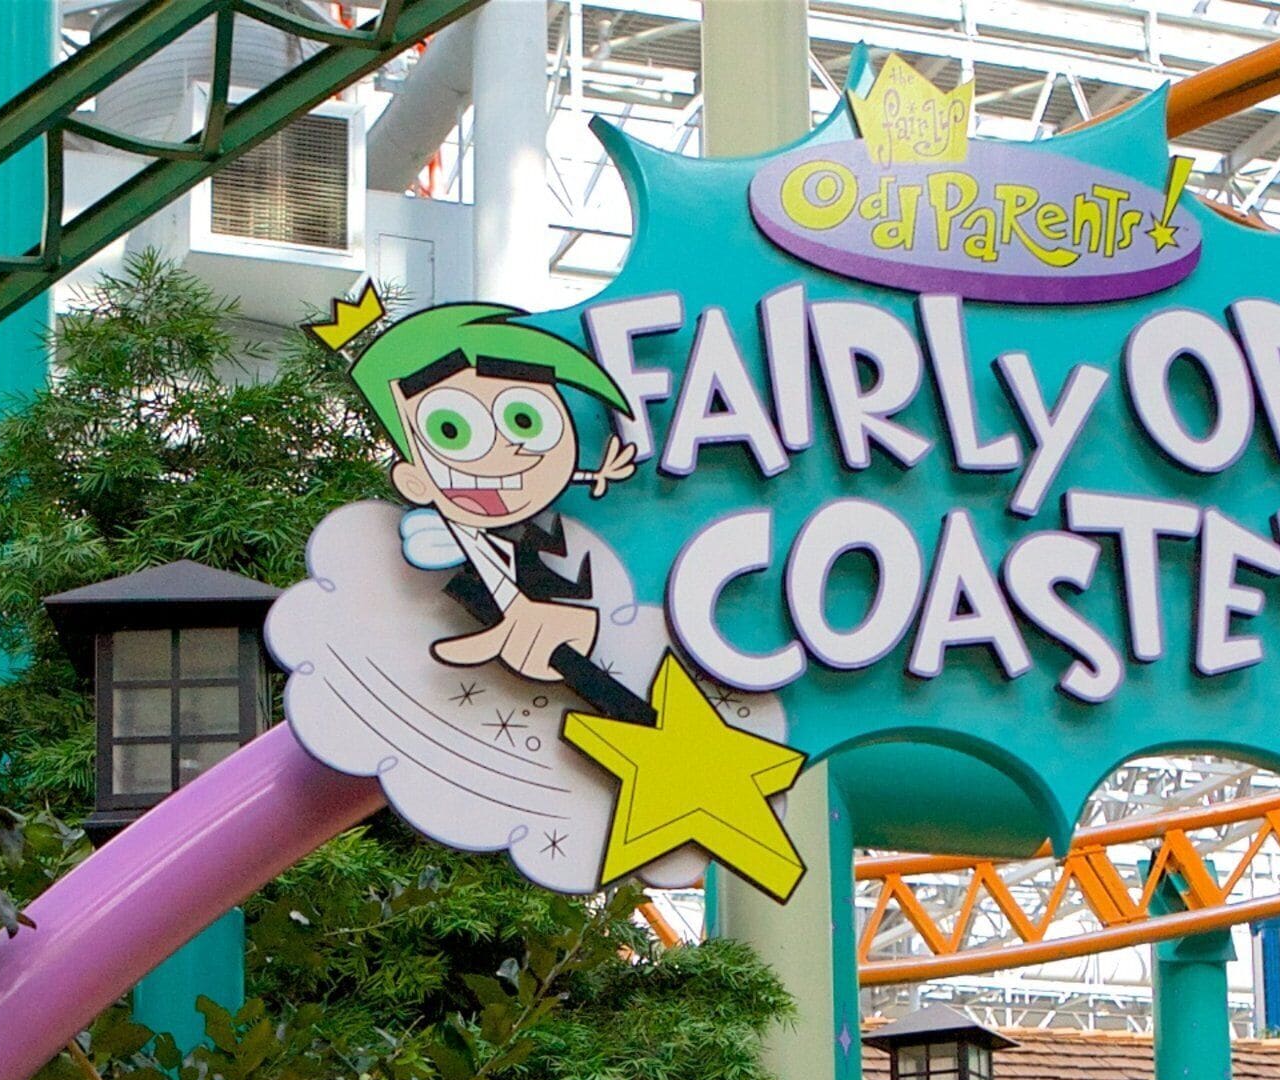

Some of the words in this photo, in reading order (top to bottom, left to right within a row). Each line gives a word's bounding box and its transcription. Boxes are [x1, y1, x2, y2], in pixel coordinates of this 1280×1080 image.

[888, 66, 915, 85] the
[877, 87, 966, 171] fairly
[583, 283, 1109, 517] FAIRLY
